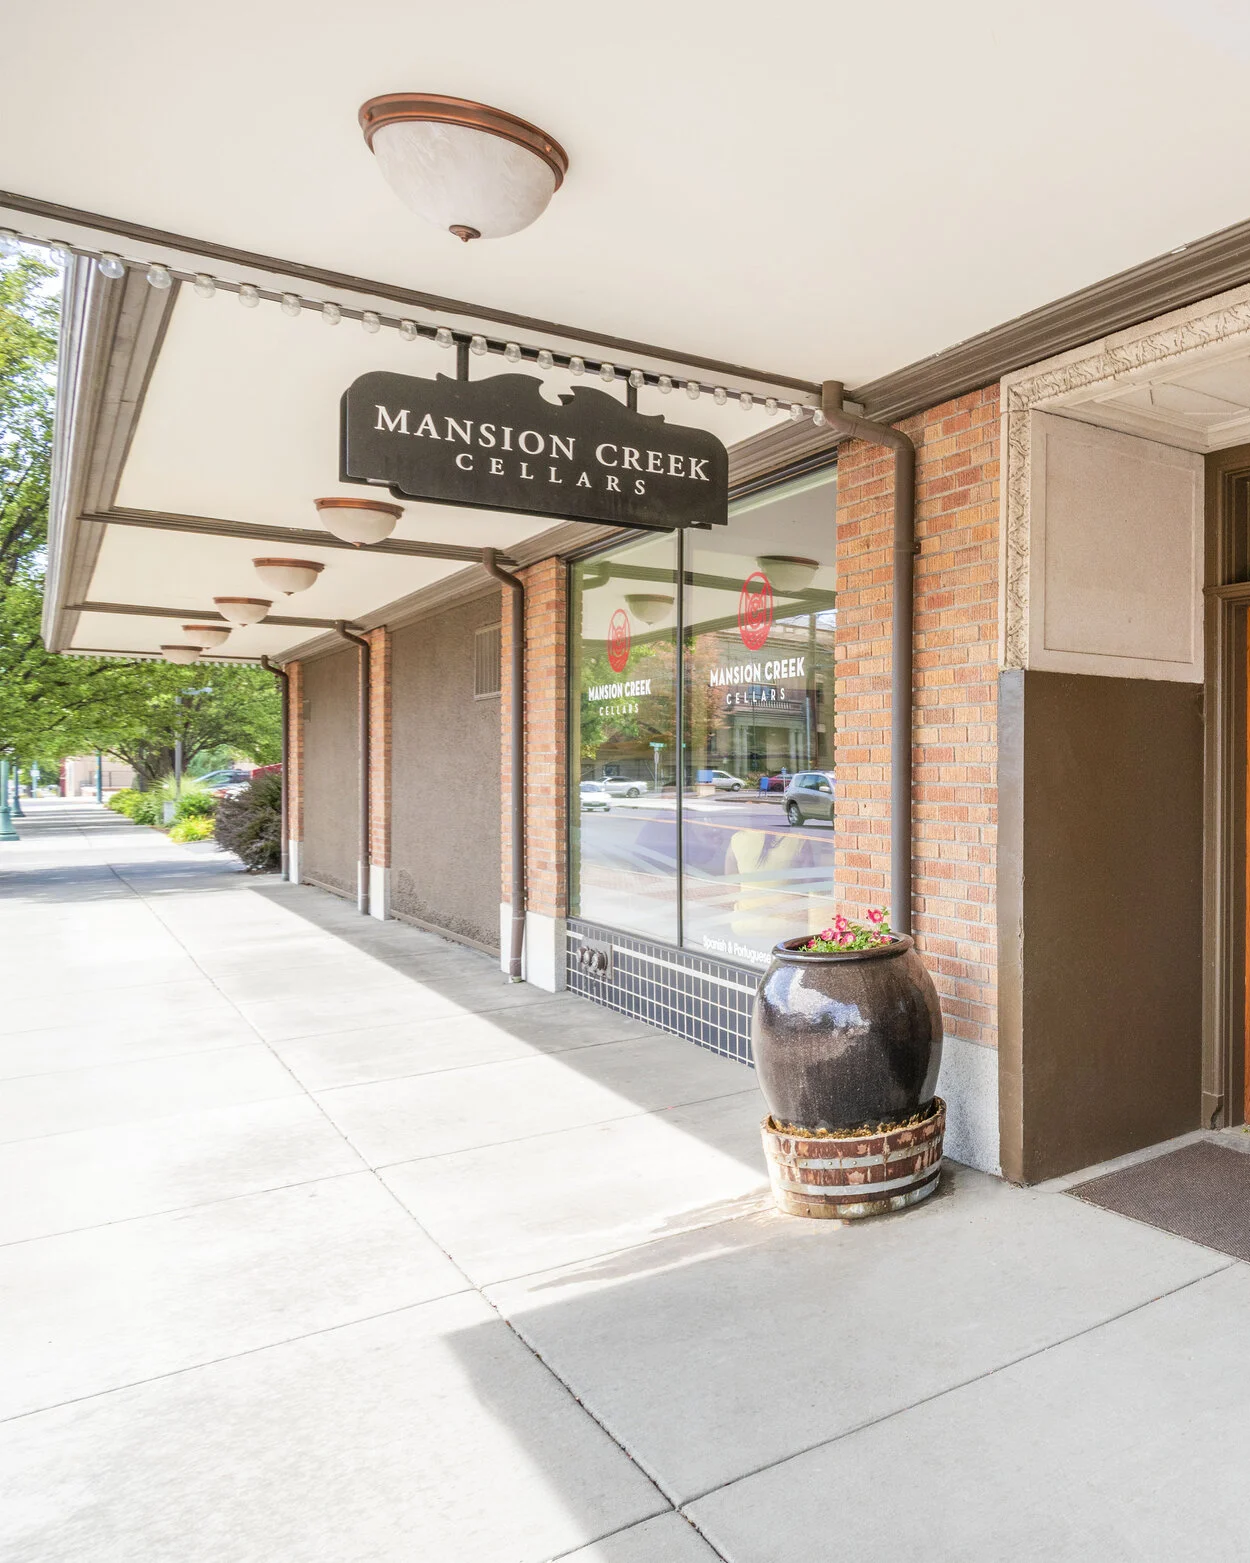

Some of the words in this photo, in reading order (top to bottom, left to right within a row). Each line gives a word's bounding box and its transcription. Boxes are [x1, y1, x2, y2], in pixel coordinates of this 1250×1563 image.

[374, 404, 576, 461] MANSION
[595, 443, 710, 482] CREEK
[455, 453, 646, 495] CELLARS
[710, 662, 761, 687] MANSION
[764, 657, 805, 680] CREEK
[588, 683, 623, 701] MANSION
[624, 679, 651, 697] CREEK
[726, 687, 785, 705] CELLARS
[599, 703, 639, 716] CELLARS
[703, 935, 727, 952] Spanish
[727, 941, 733, 954] &
[734, 942, 771, 964] Portuguese
